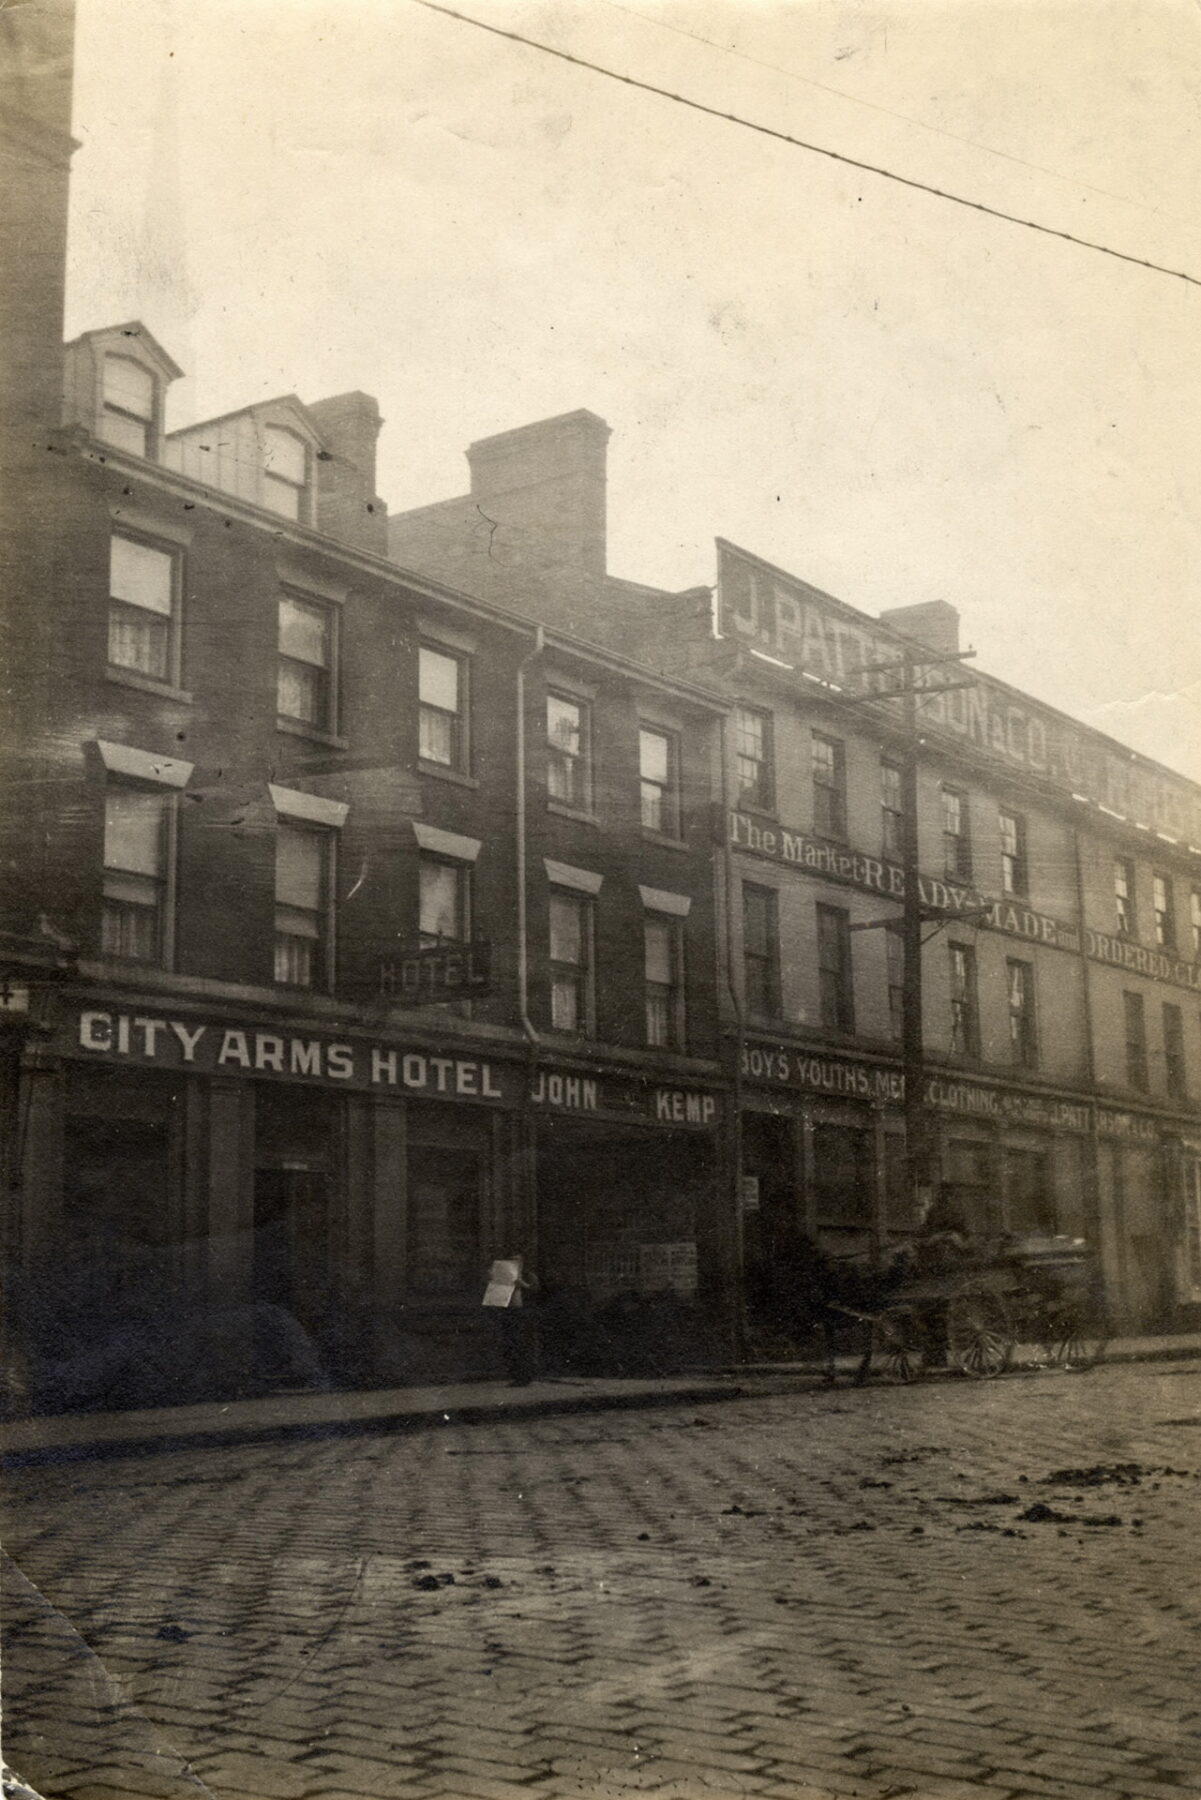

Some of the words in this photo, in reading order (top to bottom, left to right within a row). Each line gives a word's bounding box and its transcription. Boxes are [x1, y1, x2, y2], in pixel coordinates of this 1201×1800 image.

[729, 811, 776, 853] The
[380, 953, 484, 994] HOTEL
[80, 1011, 207, 1061] CITY
[218, 1030, 353, 1079] ARMS
[371, 1049, 502, 1098] HOTEL
[531, 1071, 597, 1110] JOHN
[656, 1089, 716, 1123] KEMP
